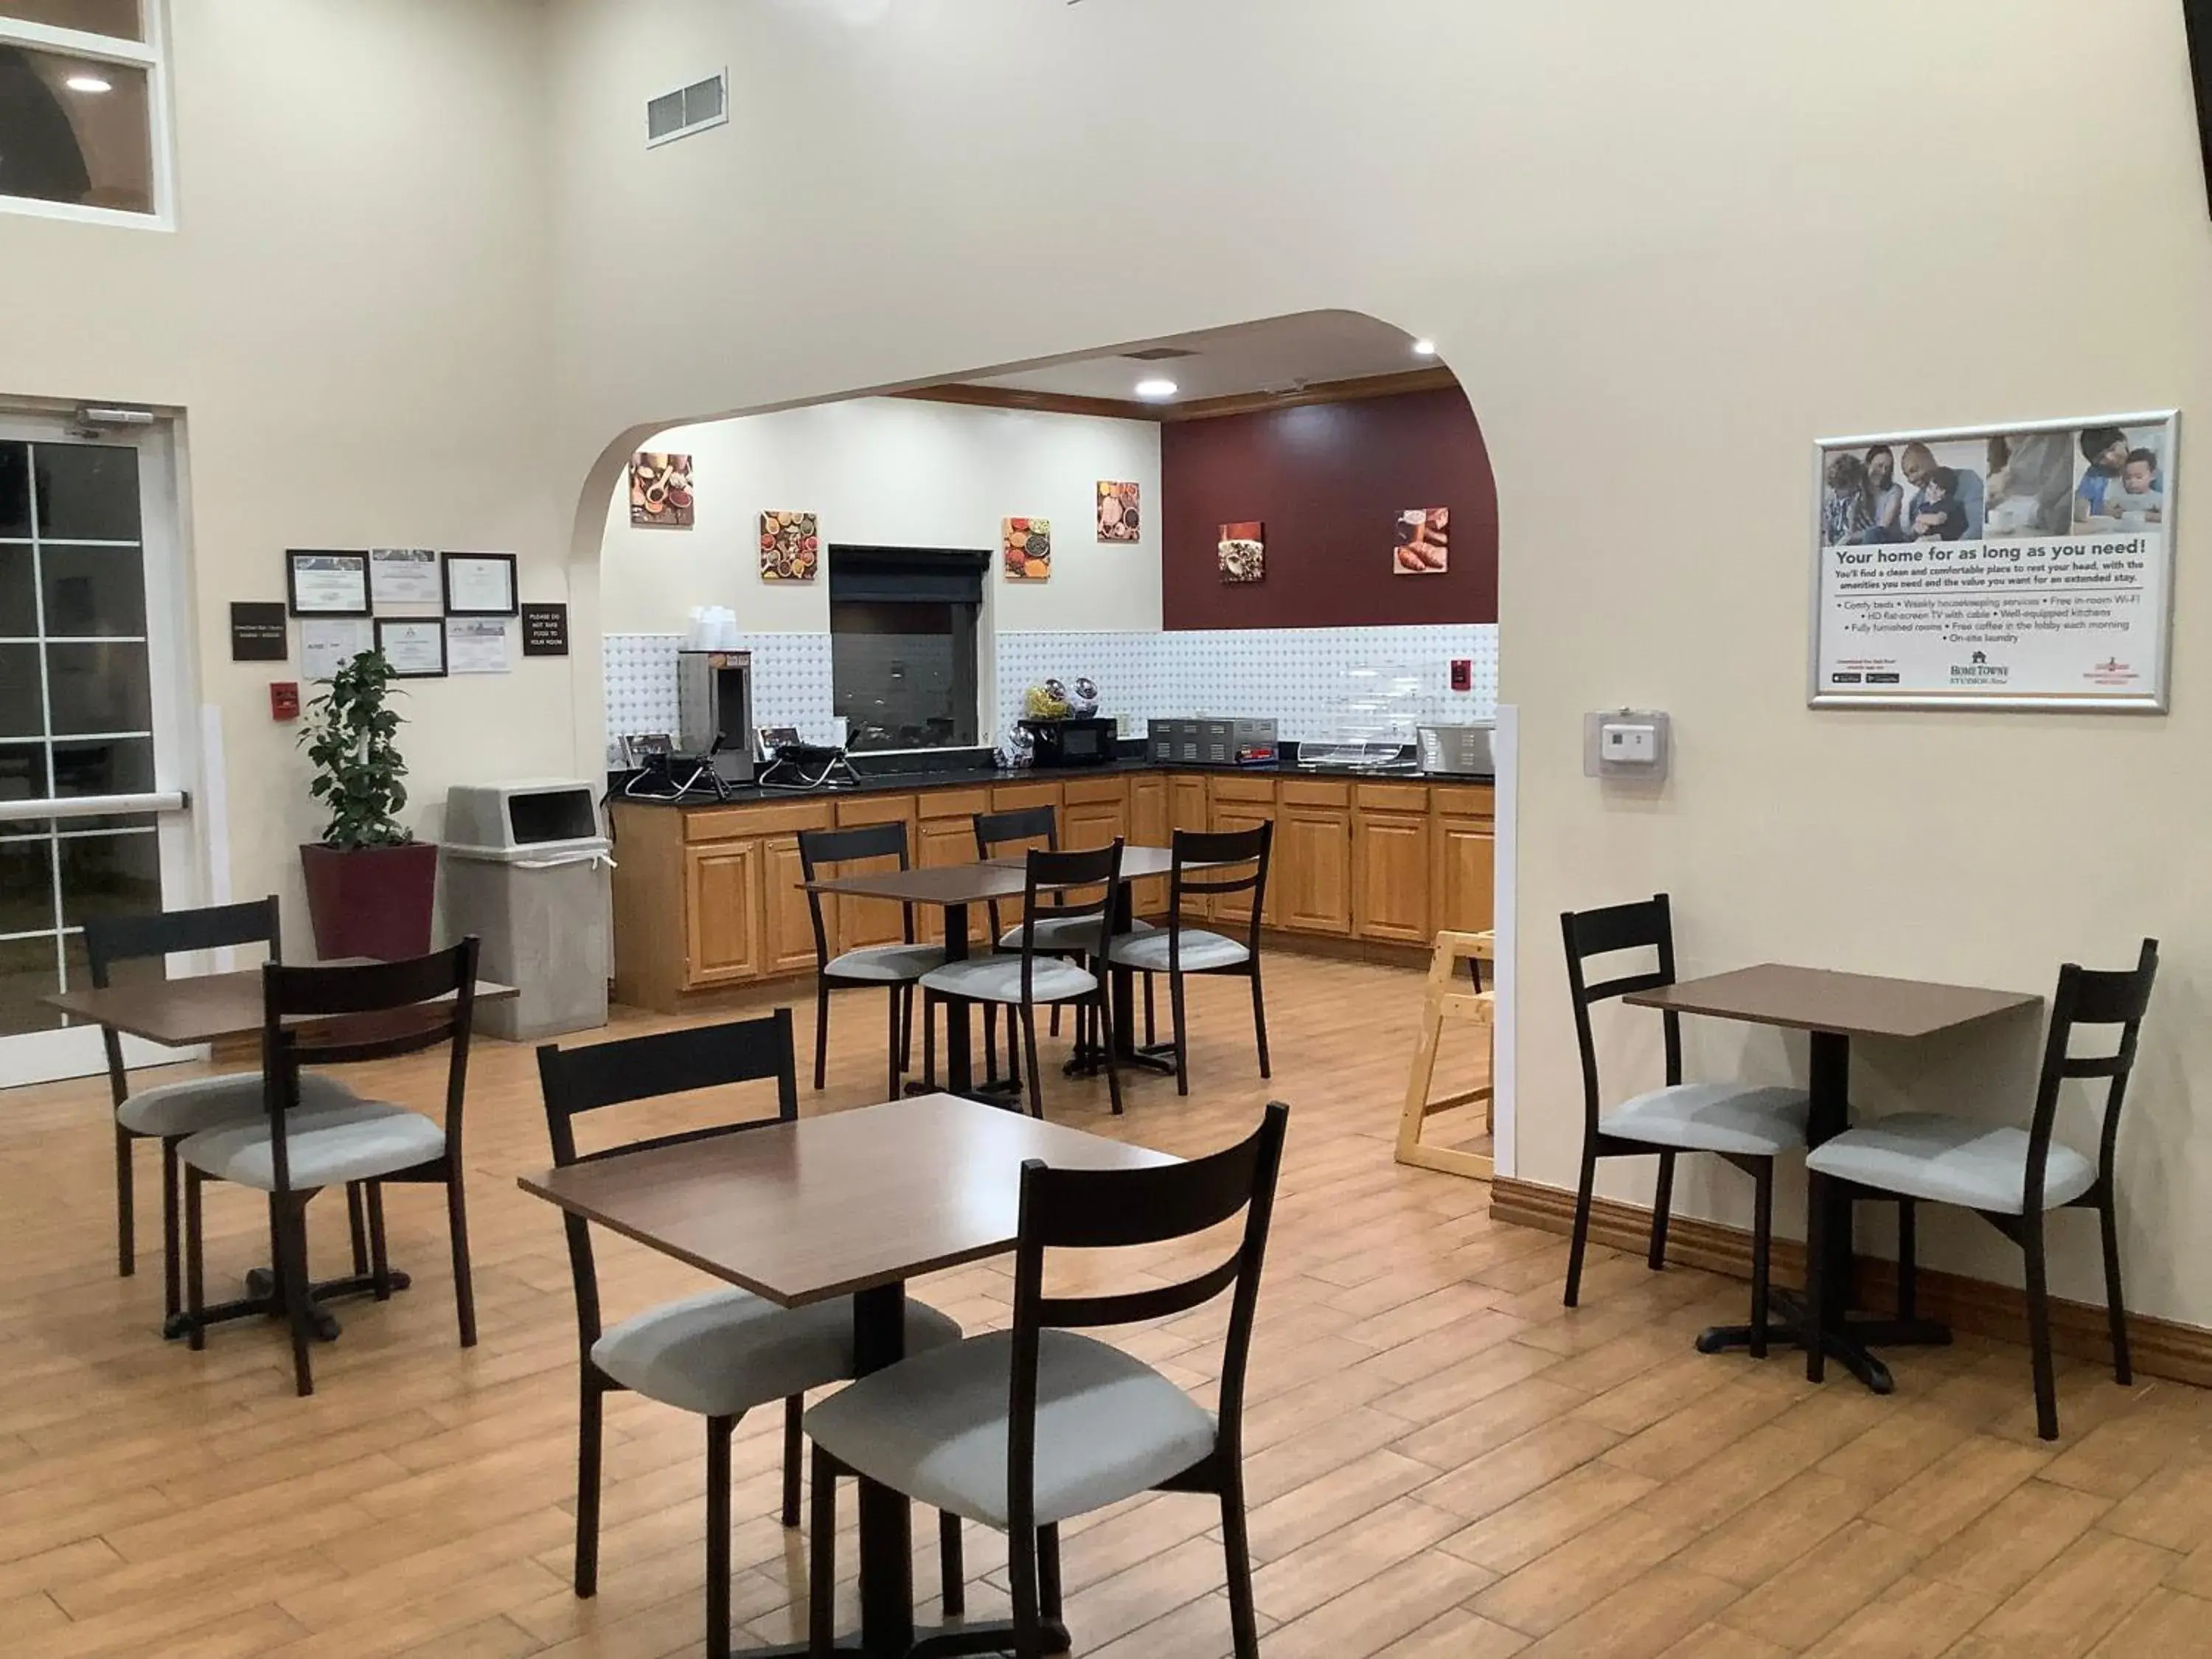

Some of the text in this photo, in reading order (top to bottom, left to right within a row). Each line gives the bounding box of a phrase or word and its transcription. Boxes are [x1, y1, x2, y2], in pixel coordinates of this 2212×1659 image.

[1836, 538, 2145, 564] Your home for as long as you need!
[1835, 569, 1857, 578] You'll
[1861, 568, 1876, 577] find
[1886, 568, 1908, 577] clean
[1911, 566, 1927, 575] and
[1930, 566, 1983, 574] comfortable
[1987, 565, 2011, 574] place
[2048, 564, 2070, 574] your
[2103, 560, 2124, 569] with
[2127, 560, 2143, 568] the
[1840, 580, 1879, 589] amenities
[1882, 582, 1898, 590] you
[1901, 579, 1922, 588] need
[1925, 578, 1941, 587] and
[1944, 577, 1958, 586] the
[1961, 577, 1985, 586] value
[1987, 578, 2005, 587] you
[2008, 577, 2031, 585] want
[2034, 575, 2048, 584] for
[2065, 573, 2111, 582] extended
[2114, 574, 2137, 582] stay.
[1903, 599, 1935, 610] Weekly
[2051, 596, 2071, 605] Free
[1868, 612, 1882, 620] HD
[1932, 610, 1943, 619] TV
[1945, 611, 1964, 619] with
[1874, 623, 1913, 632] furnished
[1952, 622, 1972, 630] Free
[1975, 621, 2003, 630] coffee
[2034, 620, 2060, 632] lobby
[2089, 622, 2130, 631] morning
[1984, 633, 2018, 644] laundry
